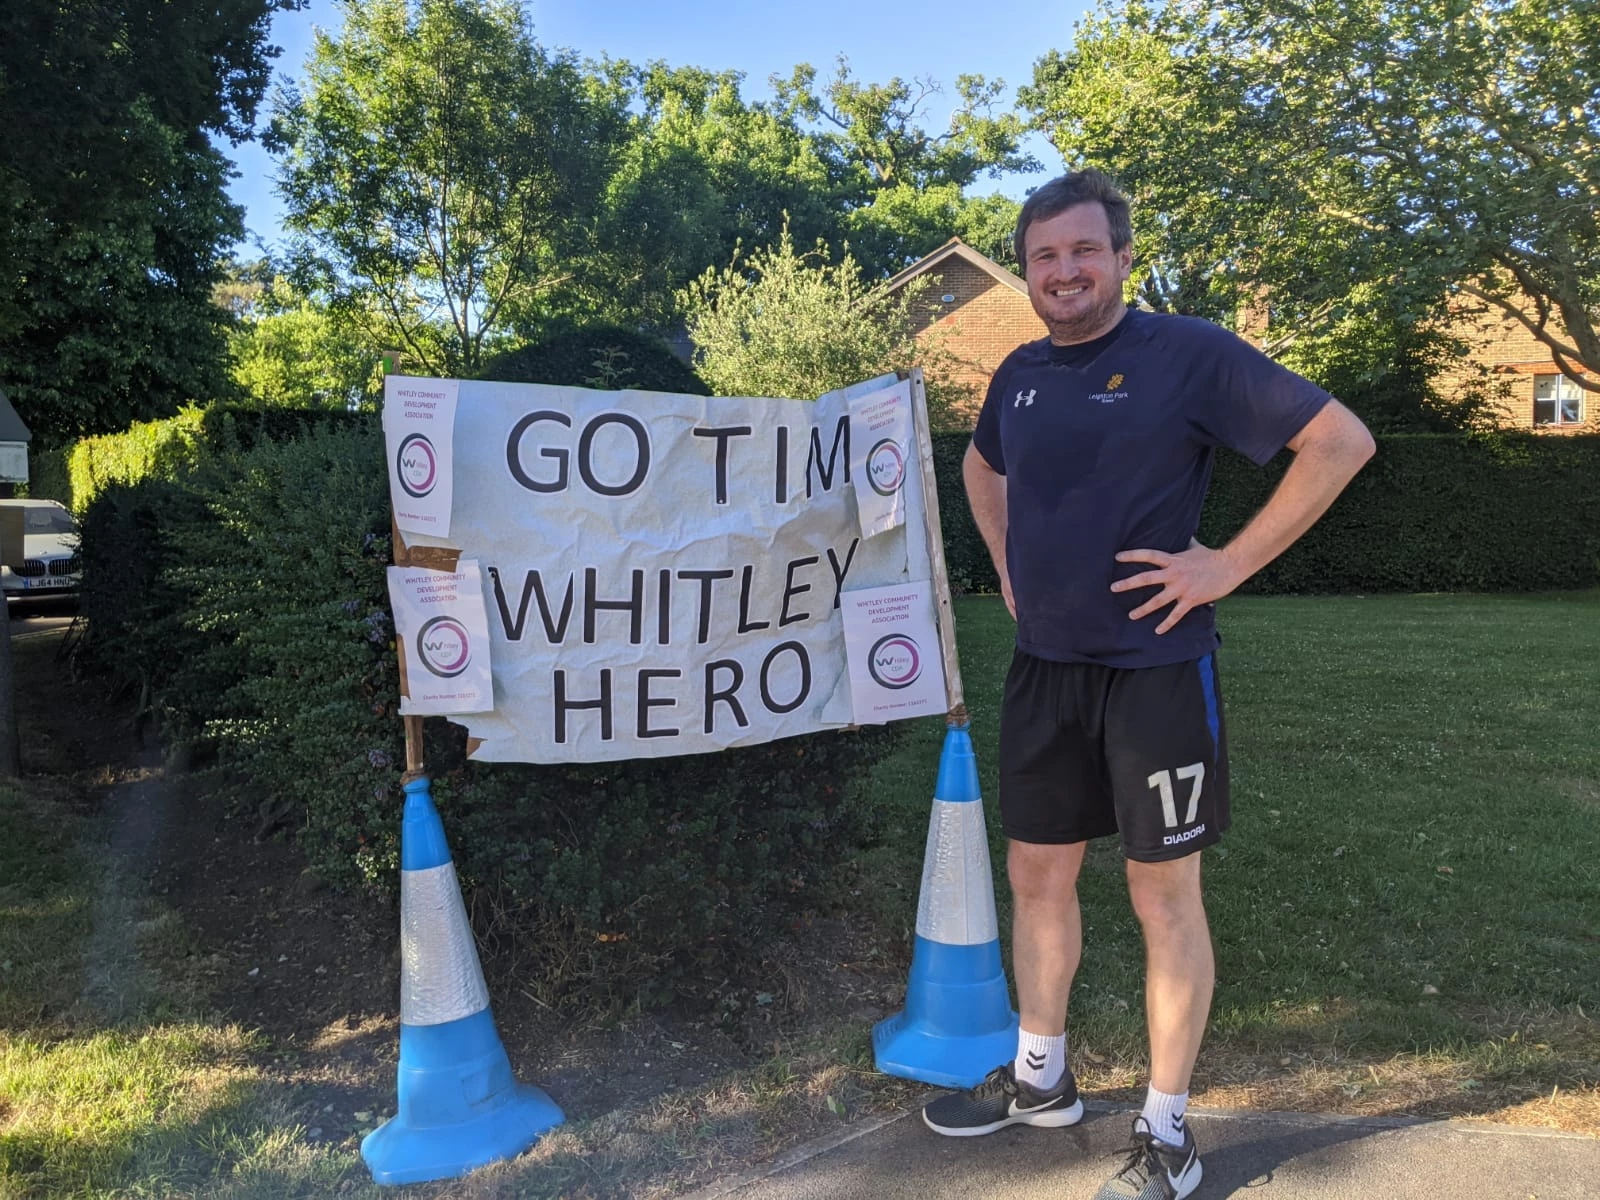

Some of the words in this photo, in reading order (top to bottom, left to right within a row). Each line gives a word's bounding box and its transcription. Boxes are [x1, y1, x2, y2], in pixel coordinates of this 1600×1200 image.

[418, 391, 447, 399] COMMUNITY
[404, 400, 437, 408] DEVELOPMENT
[404, 411, 434, 419] ASSOCIATION
[506, 410, 650, 496] GO
[694, 414, 851, 505] TIM
[405, 575, 432, 584] WHITLEY
[432, 573, 466, 582] COMMUNITY
[416, 584, 458, 593] DEVELOPMENT
[488, 537, 860, 645] WHITLEY
[420, 594, 458, 603] ASSOCIATION
[856, 599, 883, 608] WHITLEY
[883, 593, 919, 604] COMMUNITY
[868, 603, 910, 615] DEVELOPMENT
[871, 613, 910, 624] ASSOCIATION
[553, 640, 812, 744] HERO
[1147, 761, 1206, 829] 17
[1163, 823, 1206, 845] DIADORA
